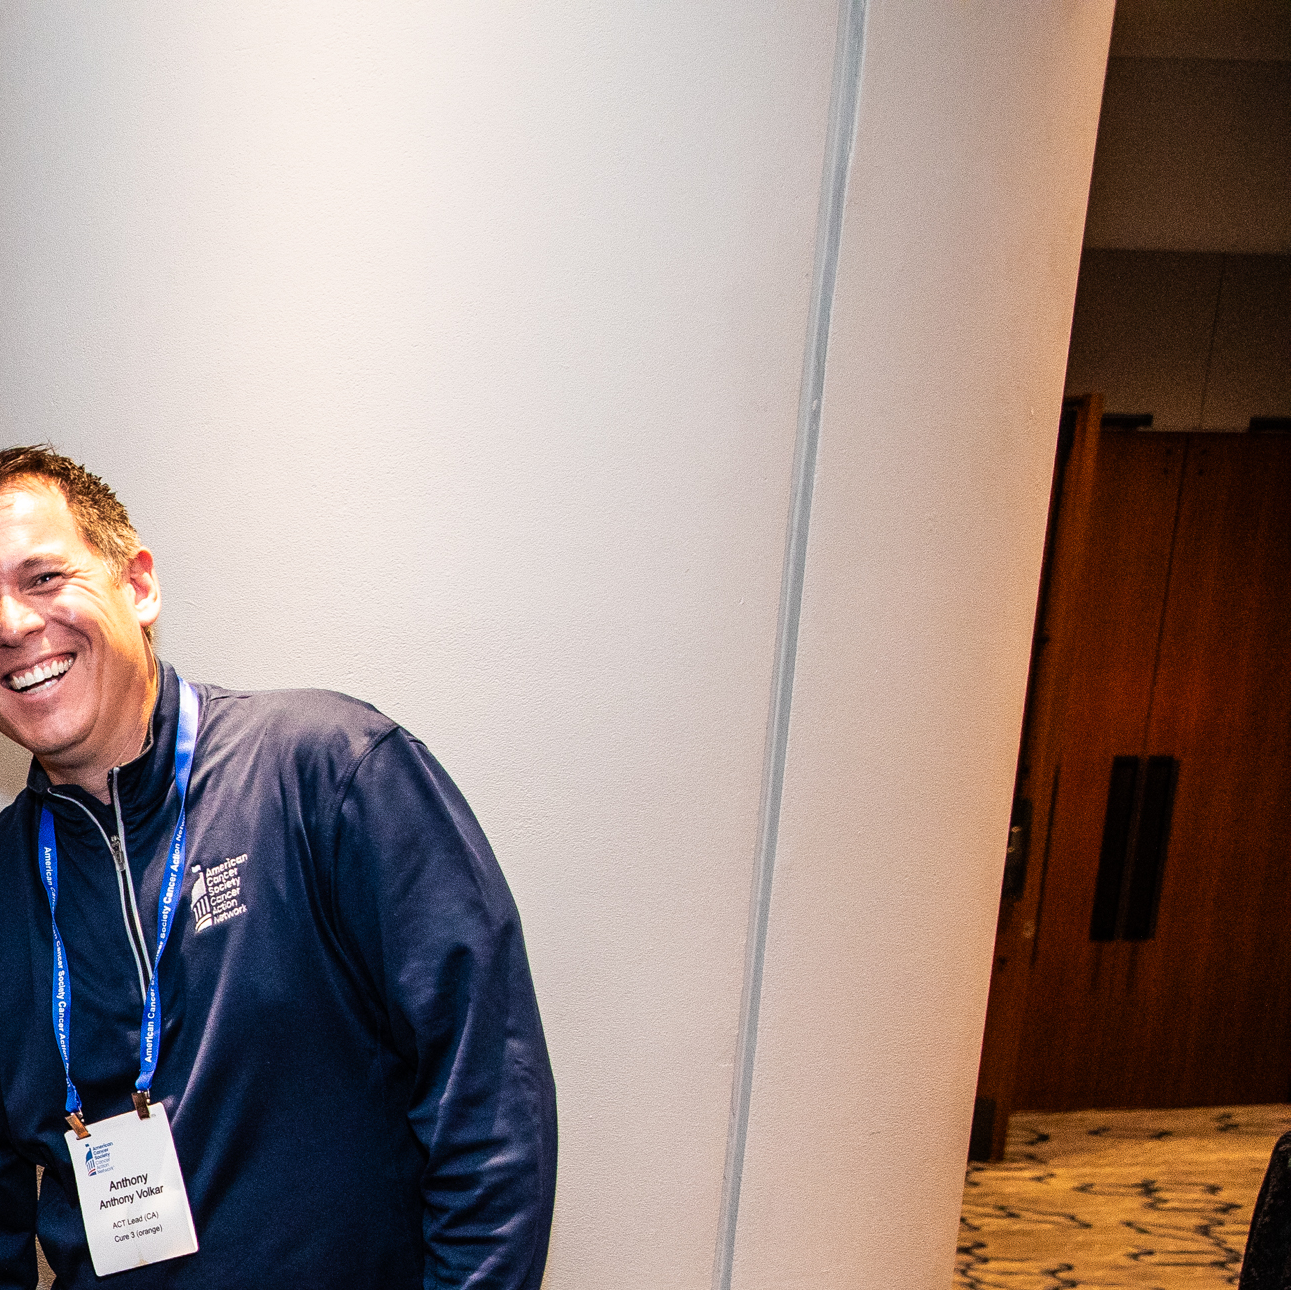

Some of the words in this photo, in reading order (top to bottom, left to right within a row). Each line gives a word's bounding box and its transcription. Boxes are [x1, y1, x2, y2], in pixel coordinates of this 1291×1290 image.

[43, 846, 53, 886] American
[171, 842, 182, 872] Action
[206, 853, 248, 878] American
[163, 872, 178, 905] Cancer
[207, 868, 238, 886] Cancer
[208, 877, 240, 896] Society
[210, 887, 240, 905] Cancer
[213, 899, 238, 914] Action
[160, 906, 171, 940] Society
[214, 904, 248, 924] Network
[56, 940, 64, 969] Cancer
[57, 970, 65, 1000] Society
[147, 986, 156, 1019] Cancer
[58, 1001, 66, 1032] Cancer
[145, 1019, 155, 1063] American
[93, 1142, 113, 1150] American
[109, 1173, 148, 1192] Anthony
[99, 1193, 134, 1210] Anthony
[136, 1185, 164, 1199] Volkar
[113, 1220, 126, 1229] ACT
[128, 1215, 143, 1225] Lead
[144, 1211, 159, 1222] (CA)
[114, 1232, 129, 1242] Cure
[137, 1224, 163, 1238] (orange)
